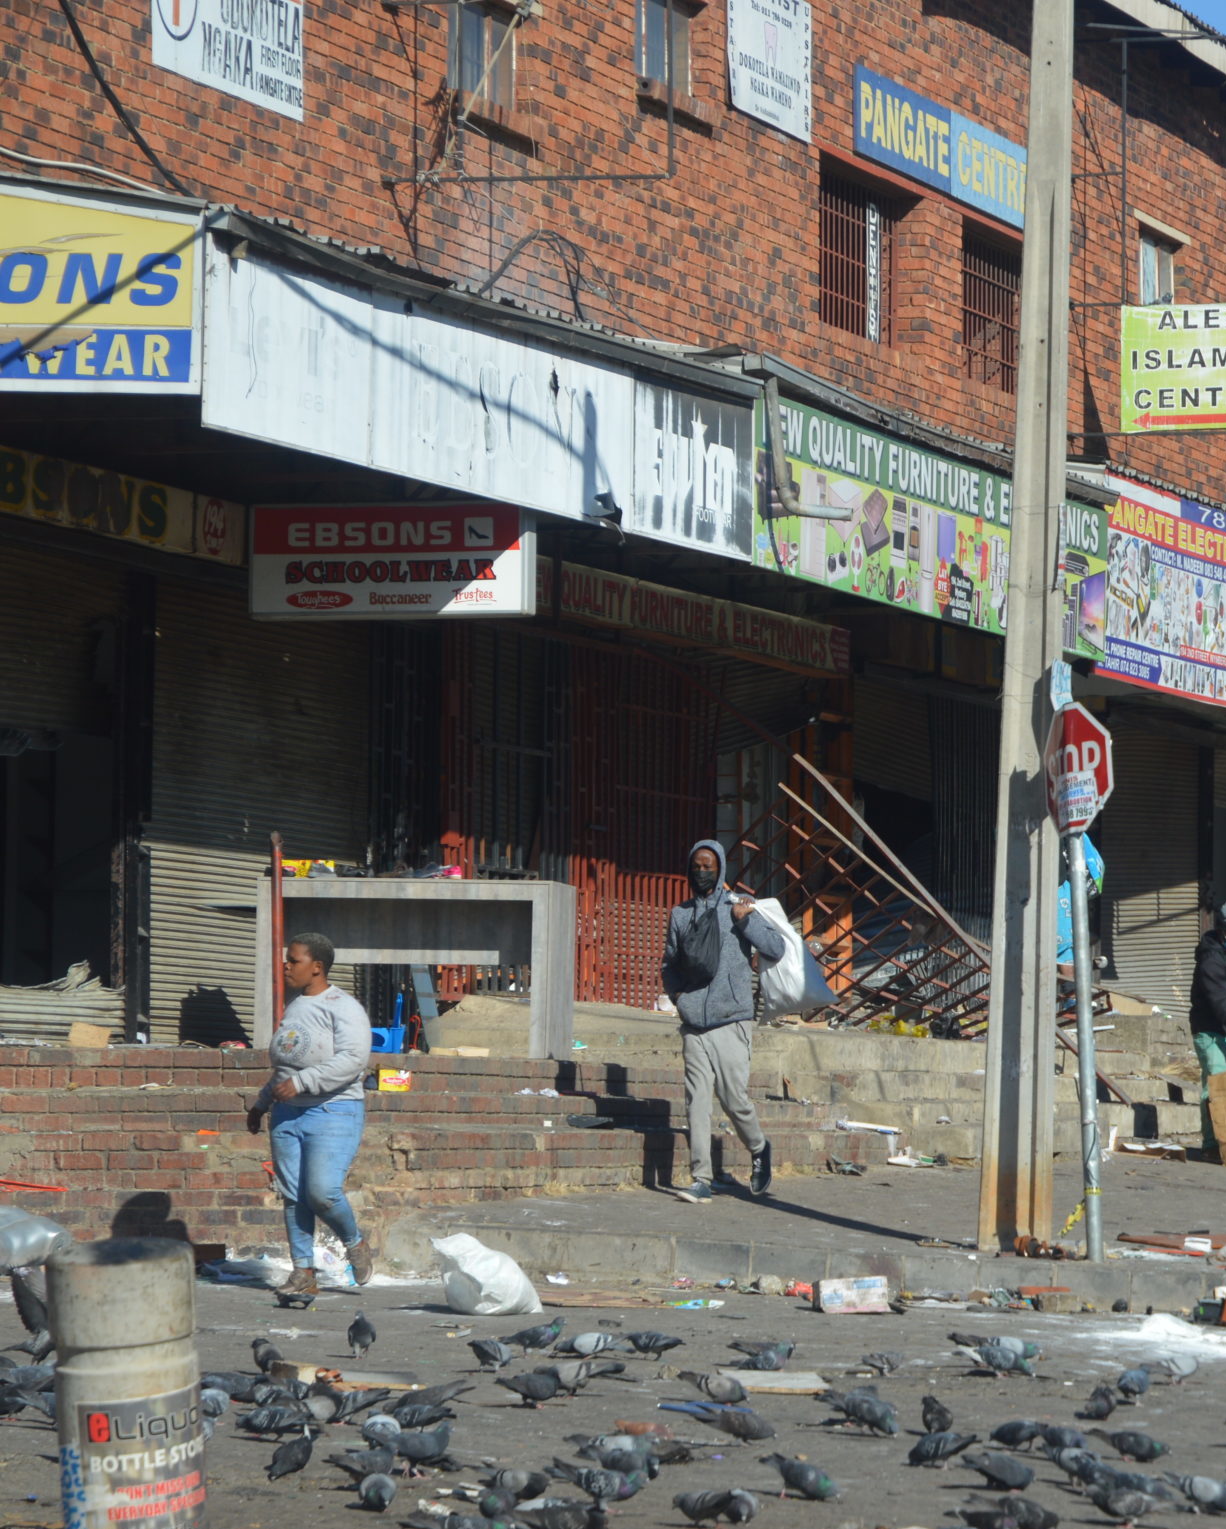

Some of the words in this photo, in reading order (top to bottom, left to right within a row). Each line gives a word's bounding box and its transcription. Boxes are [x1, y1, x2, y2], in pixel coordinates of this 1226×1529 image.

[201, 20, 254, 90] NGAKA
[260, 44, 281, 71] FIRST
[281, 53, 302, 80] FLOOR
[859, 80, 950, 178] PANGATE
[808, 415, 884, 485] QUALITY
[888, 444, 980, 518] FURNITURE
[983, 477, 996, 521] &
[287, 519, 453, 549] EBSONS
[285, 556, 497, 586] SCHOOLWEAR
[1151, 545, 1177, 567] CONTACT:
[294, 591, 342, 610] Toughees
[368, 590, 433, 606] Buccaneer
[453, 585, 494, 606] Trustees
[562, 569, 627, 621] QUALITY
[629, 585, 713, 645] FURNITURE
[732, 607, 827, 667] ELECTRONICS
[1111, 643, 1127, 659] PHONE
[1126, 648, 1142, 664] REPAIR
[1142, 652, 1160, 668] CENTRE
[90, 1449, 166, 1474] BOTTLE
[155, 1475, 181, 1496] MISS
[107, 1501, 167, 1521] EVERYDAY
